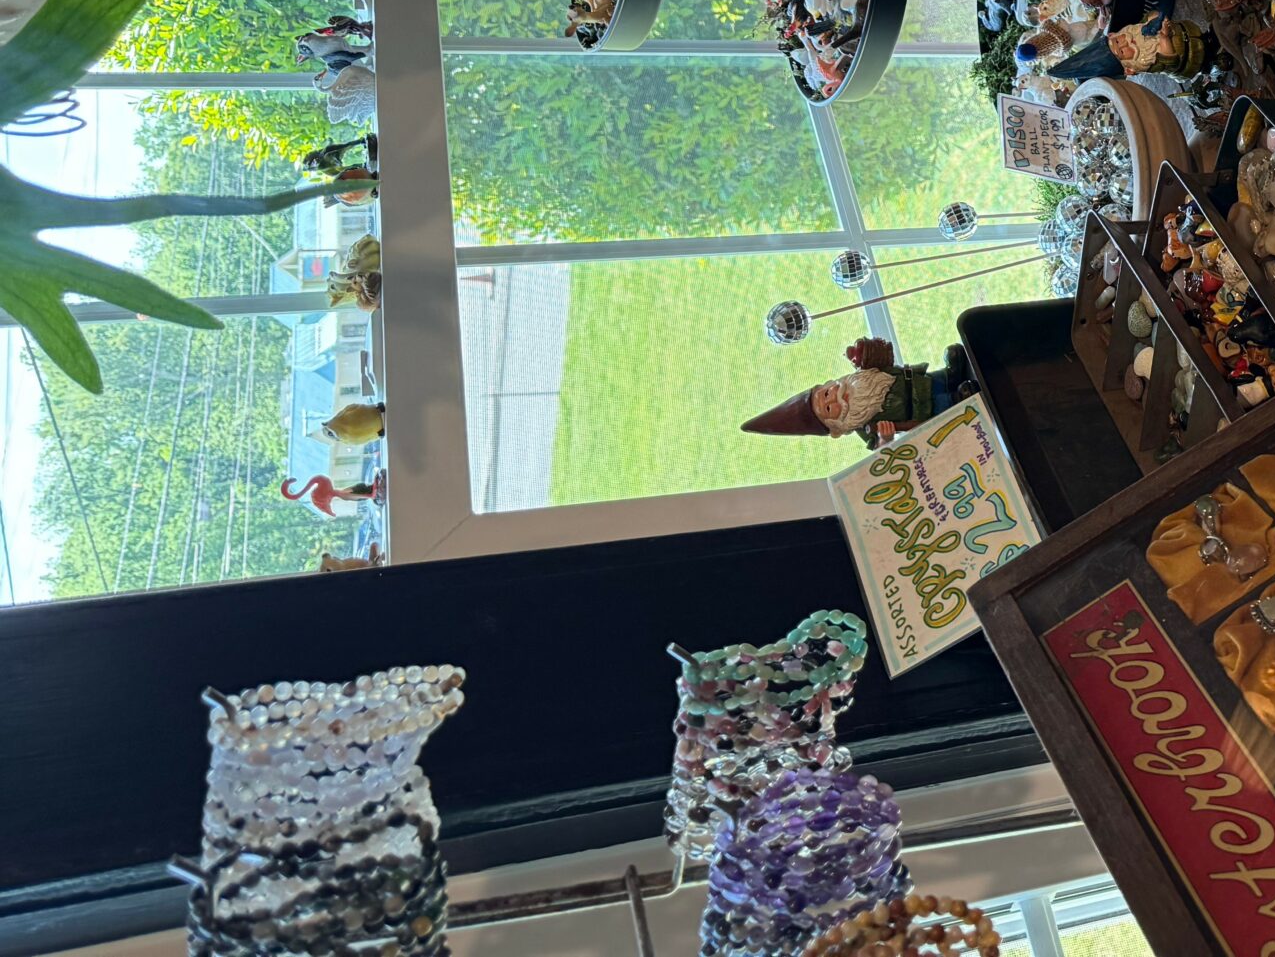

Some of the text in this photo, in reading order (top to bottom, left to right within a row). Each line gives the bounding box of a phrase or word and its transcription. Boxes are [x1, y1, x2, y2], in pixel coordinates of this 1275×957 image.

[1006, 104, 1031, 168] DISCO
[1028, 127, 1041, 155] BALL
[1038, 109, 1052, 173] PLANT DECOR
[976, 453, 988, 466] IN
[882, 574, 919, 659] ASSORTED
